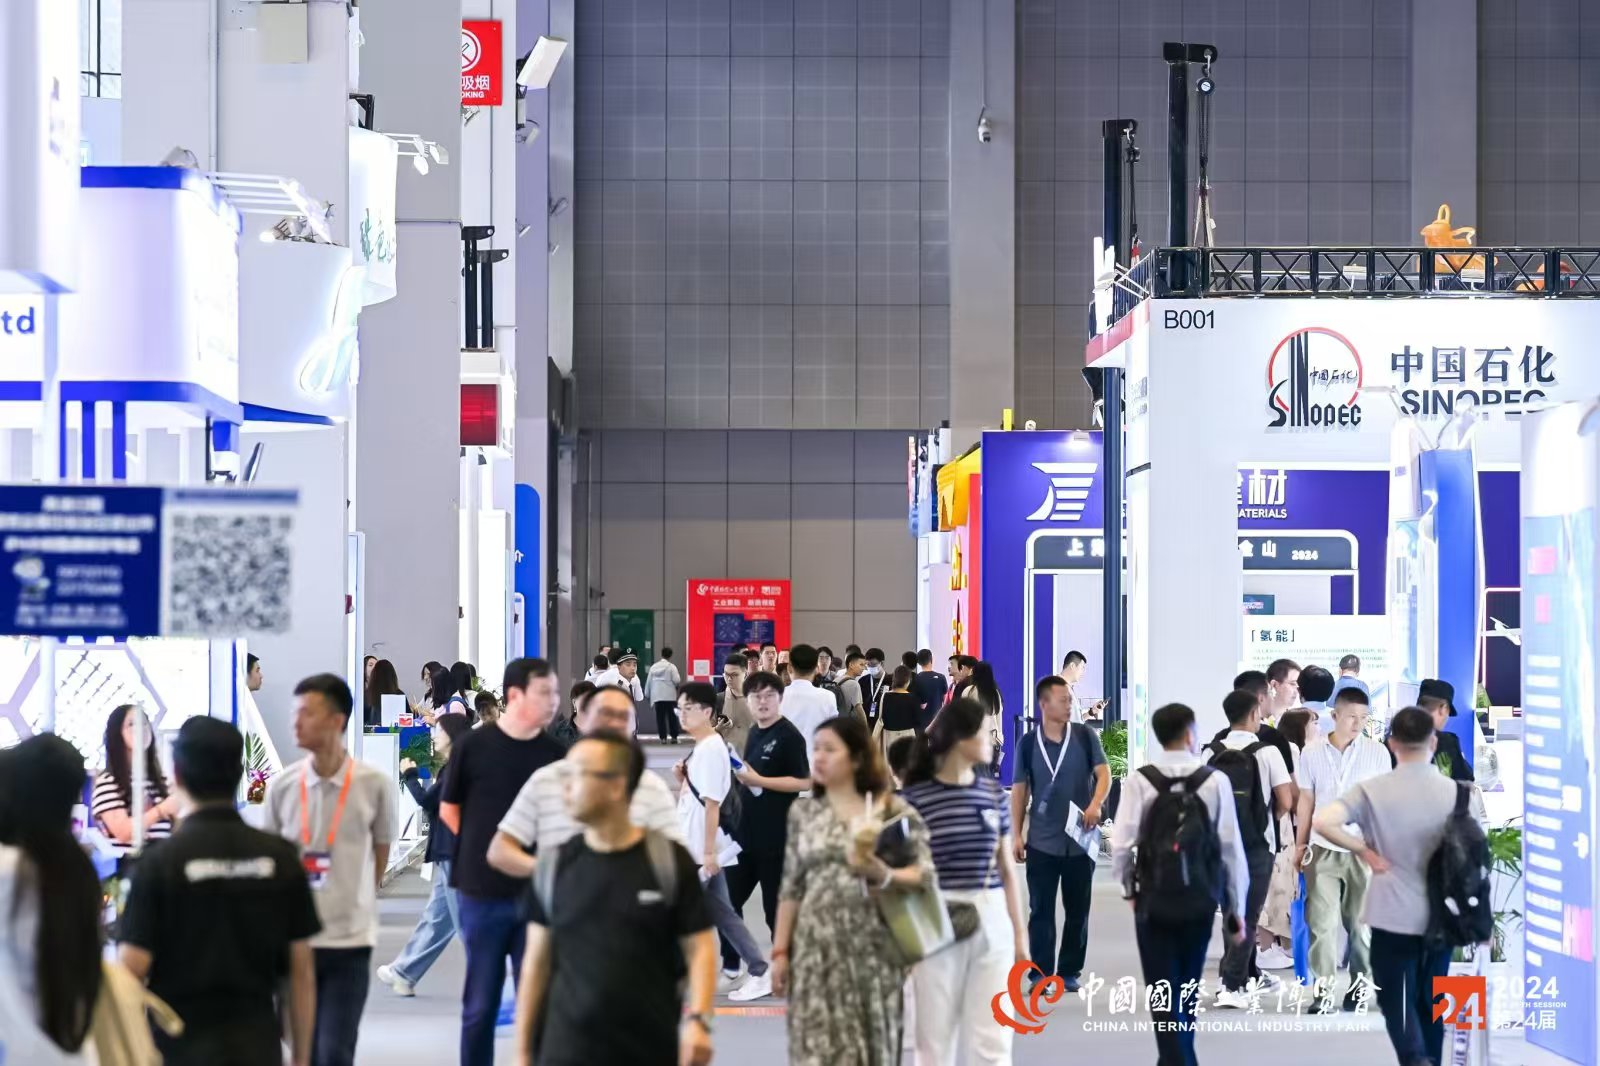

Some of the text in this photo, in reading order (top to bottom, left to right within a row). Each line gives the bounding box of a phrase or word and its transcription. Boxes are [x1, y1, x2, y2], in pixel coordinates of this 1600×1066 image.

[1, 306, 35, 335] td
[1164, 309, 1215, 329] B001
[1391, 344, 1556, 383] 中国石化
[1237, 469, 1288, 505] 材
[1237, 508, 1287, 519] ATERIALS
